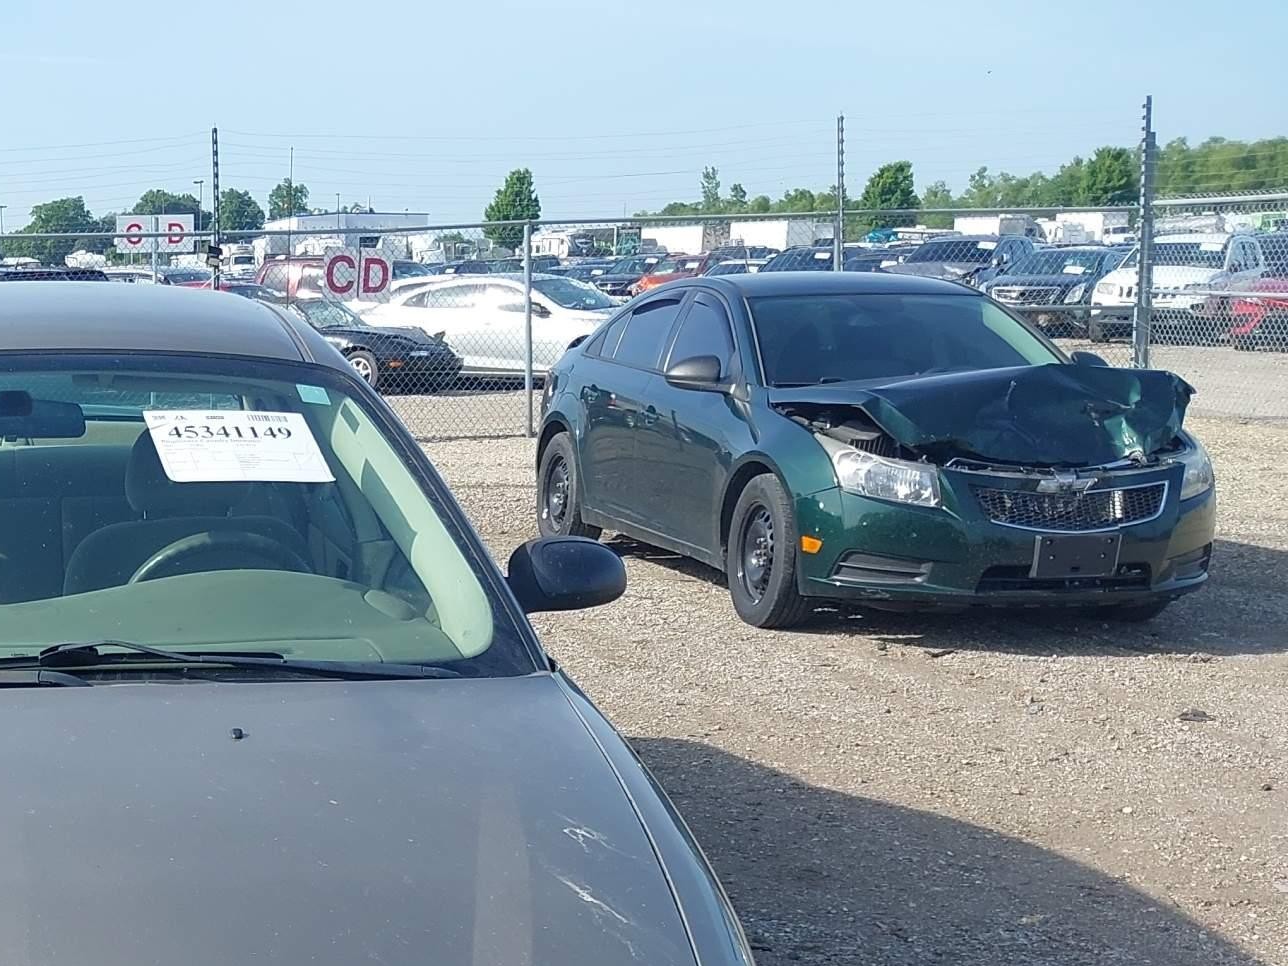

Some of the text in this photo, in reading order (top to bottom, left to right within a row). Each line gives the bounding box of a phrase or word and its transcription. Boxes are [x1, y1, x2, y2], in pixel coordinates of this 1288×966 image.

[126, 223, 184, 245] C D
[326, 255, 389, 294] C D
[167, 425, 292, 440] 45341149
